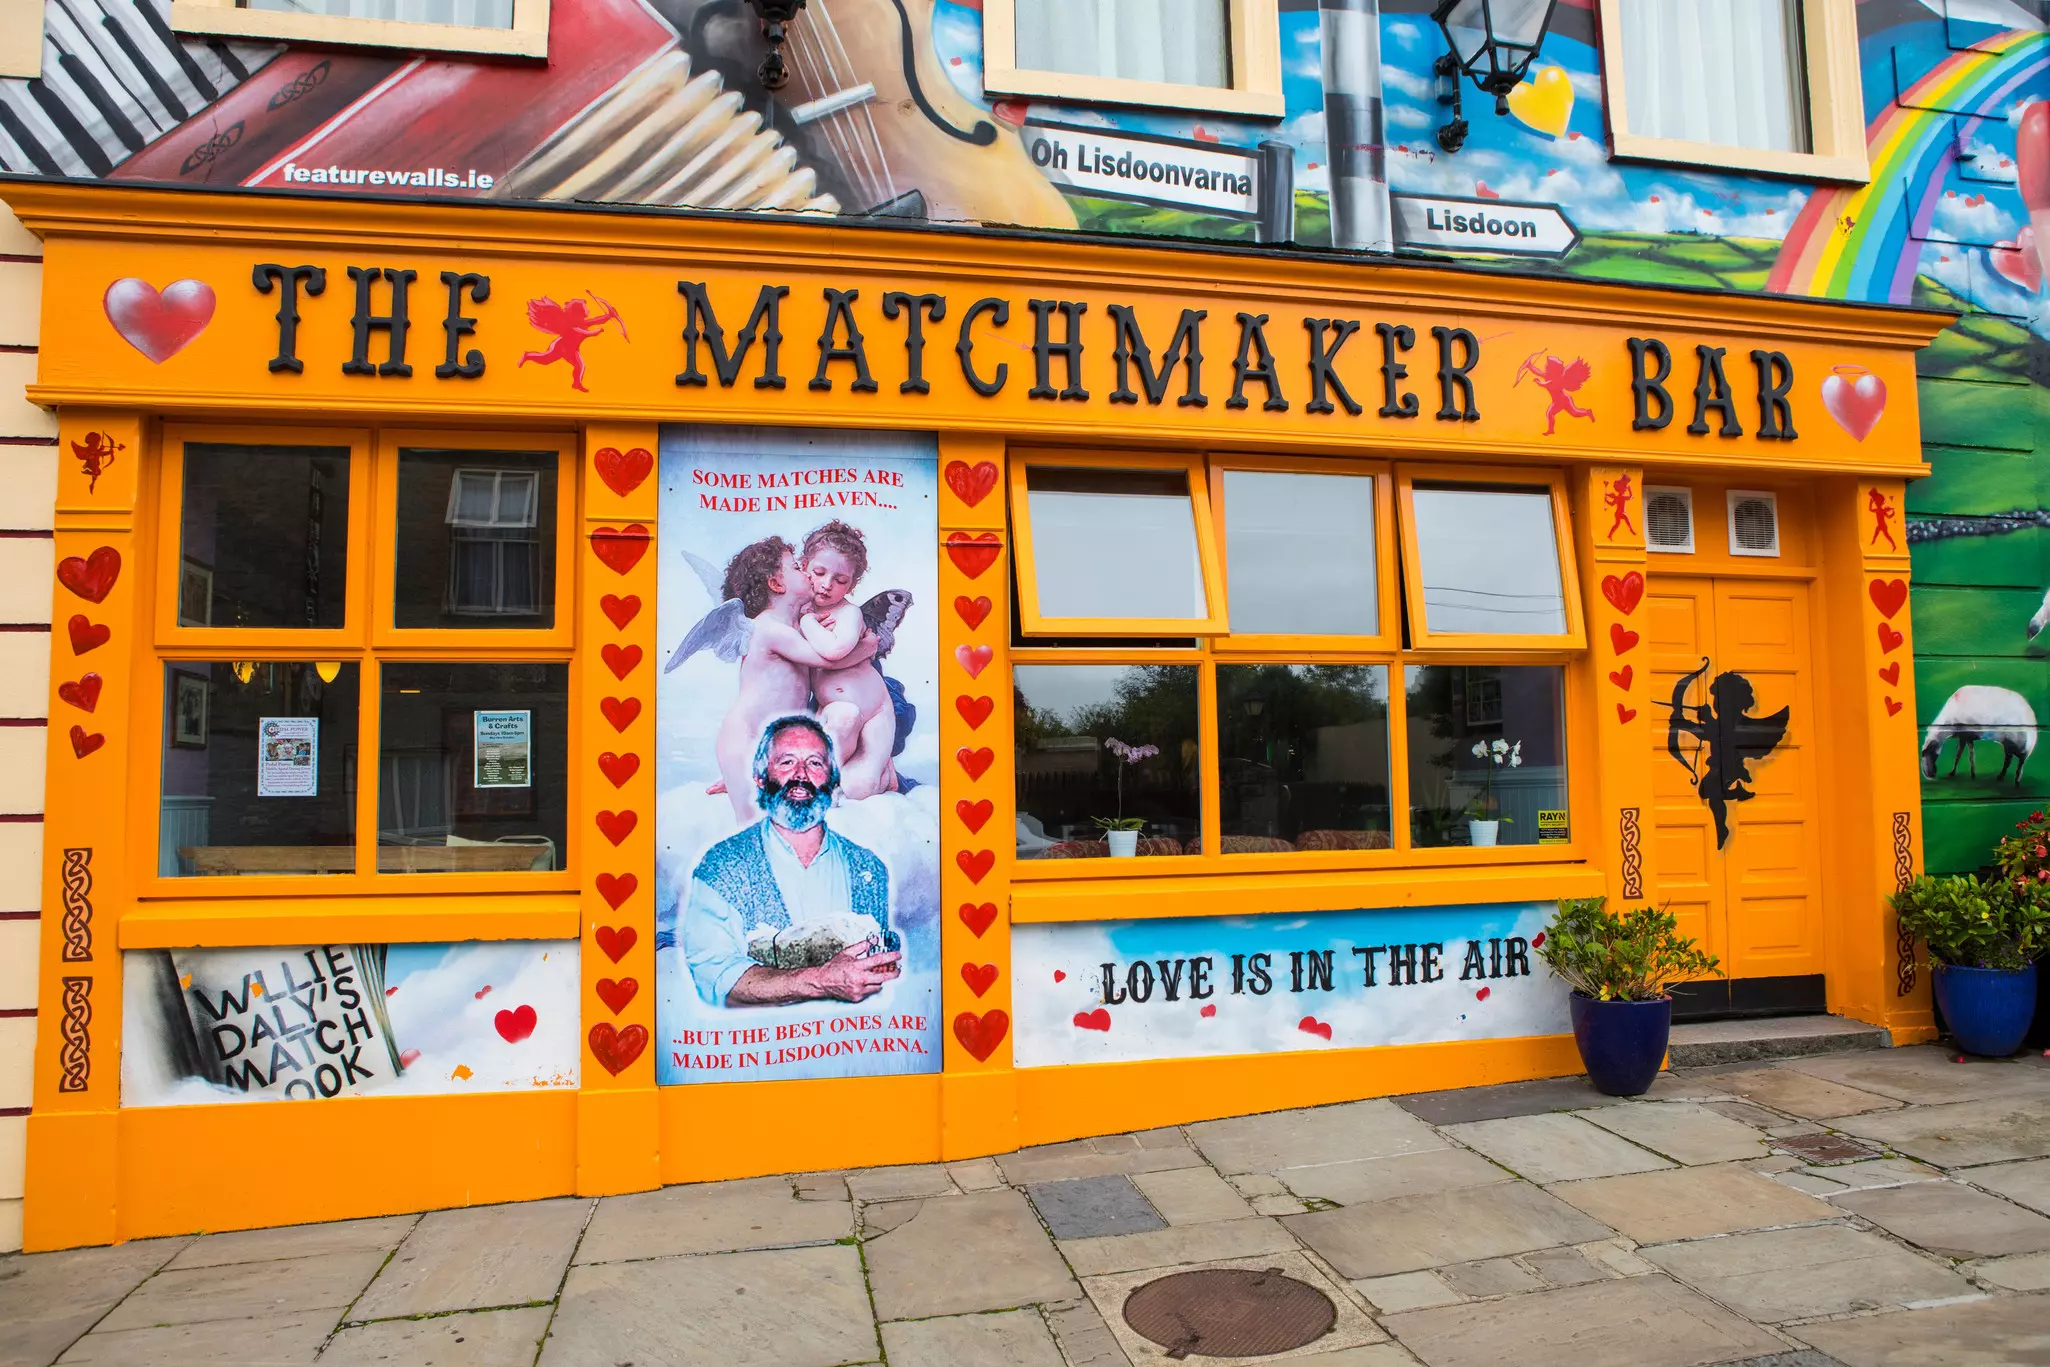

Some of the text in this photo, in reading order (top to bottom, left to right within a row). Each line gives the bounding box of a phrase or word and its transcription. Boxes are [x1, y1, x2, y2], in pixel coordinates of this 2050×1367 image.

[283, 162, 494, 190] featurewalls.ie
[1031, 137, 1253, 197] Oh Lisdoonvarna
[1426, 208, 1537, 239] Lisdoon
[252, 263, 1799, 441] THE MATCHMAKER BAR
[692, 467, 905, 489] SOME MATCHES ARE
[699, 493, 761, 513] MADE
[766, 494, 787, 511] IN
[1540, 812, 1565, 820] RAYN
[1099, 937, 1531, 1005] LOVE IS IN THE AIR
[212, 976, 361, 1061] DALY'S
[728, 1027, 770, 1044] THE
[776, 1020, 825, 1041] BEST
[829, 1014, 882, 1036] ONES
[887, 1014, 927, 1032] ARE
[226, 1007, 374, 1092] MATCH
[672, 1037, 929, 1070] MADE IN LISDOONVARNA.
